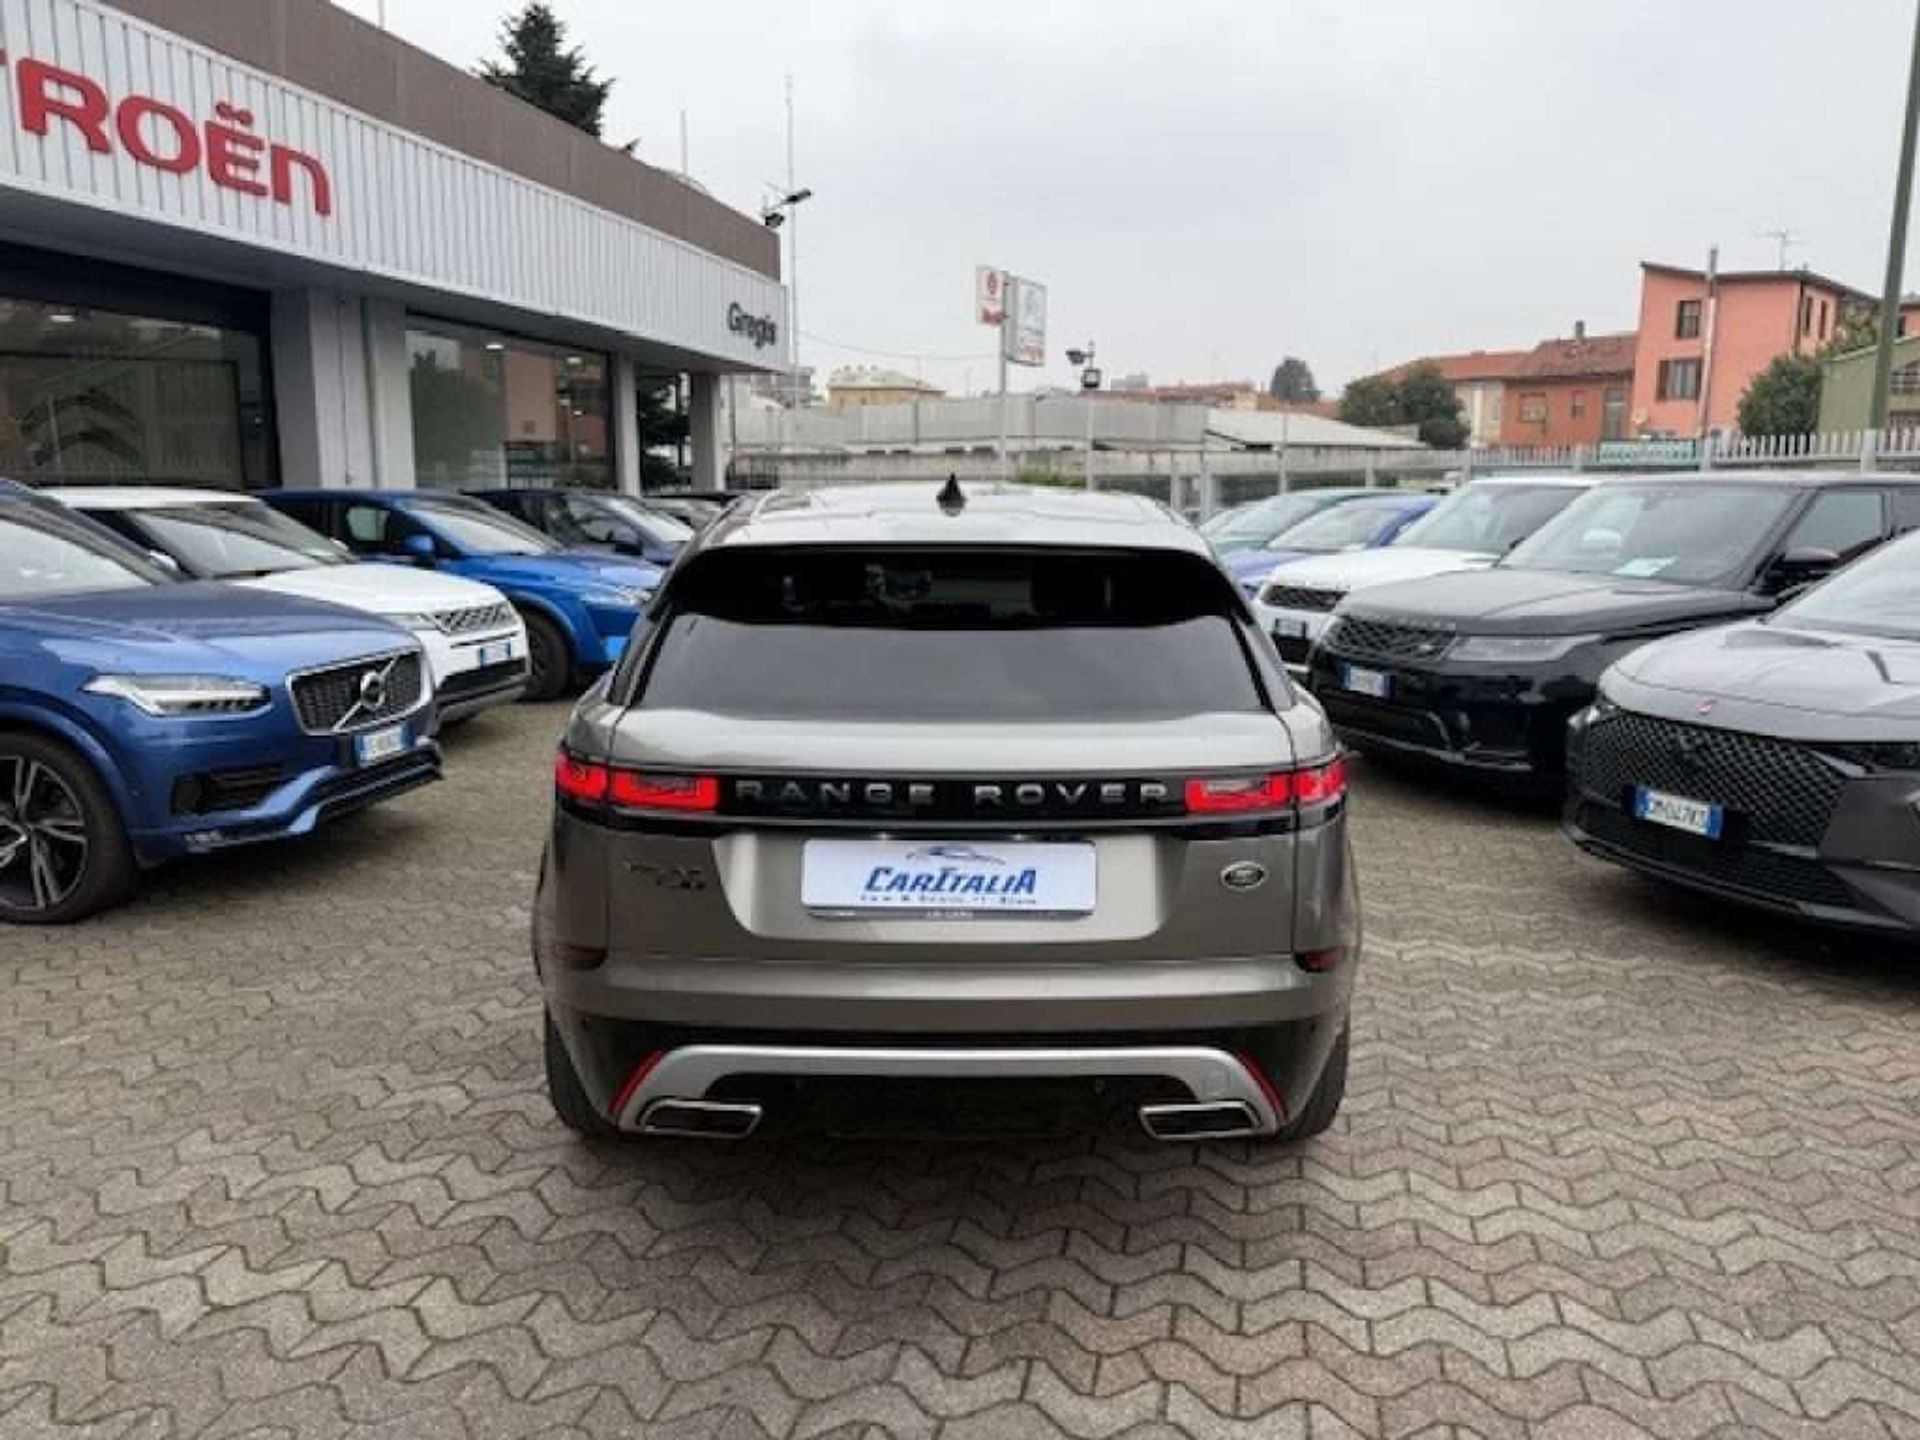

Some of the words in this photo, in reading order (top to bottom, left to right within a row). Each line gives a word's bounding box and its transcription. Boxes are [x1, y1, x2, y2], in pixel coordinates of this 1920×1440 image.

[0, 48, 331, 216] ROËN
[735, 779, 935, 806] RANGE
[974, 782, 1168, 806] ROVER
